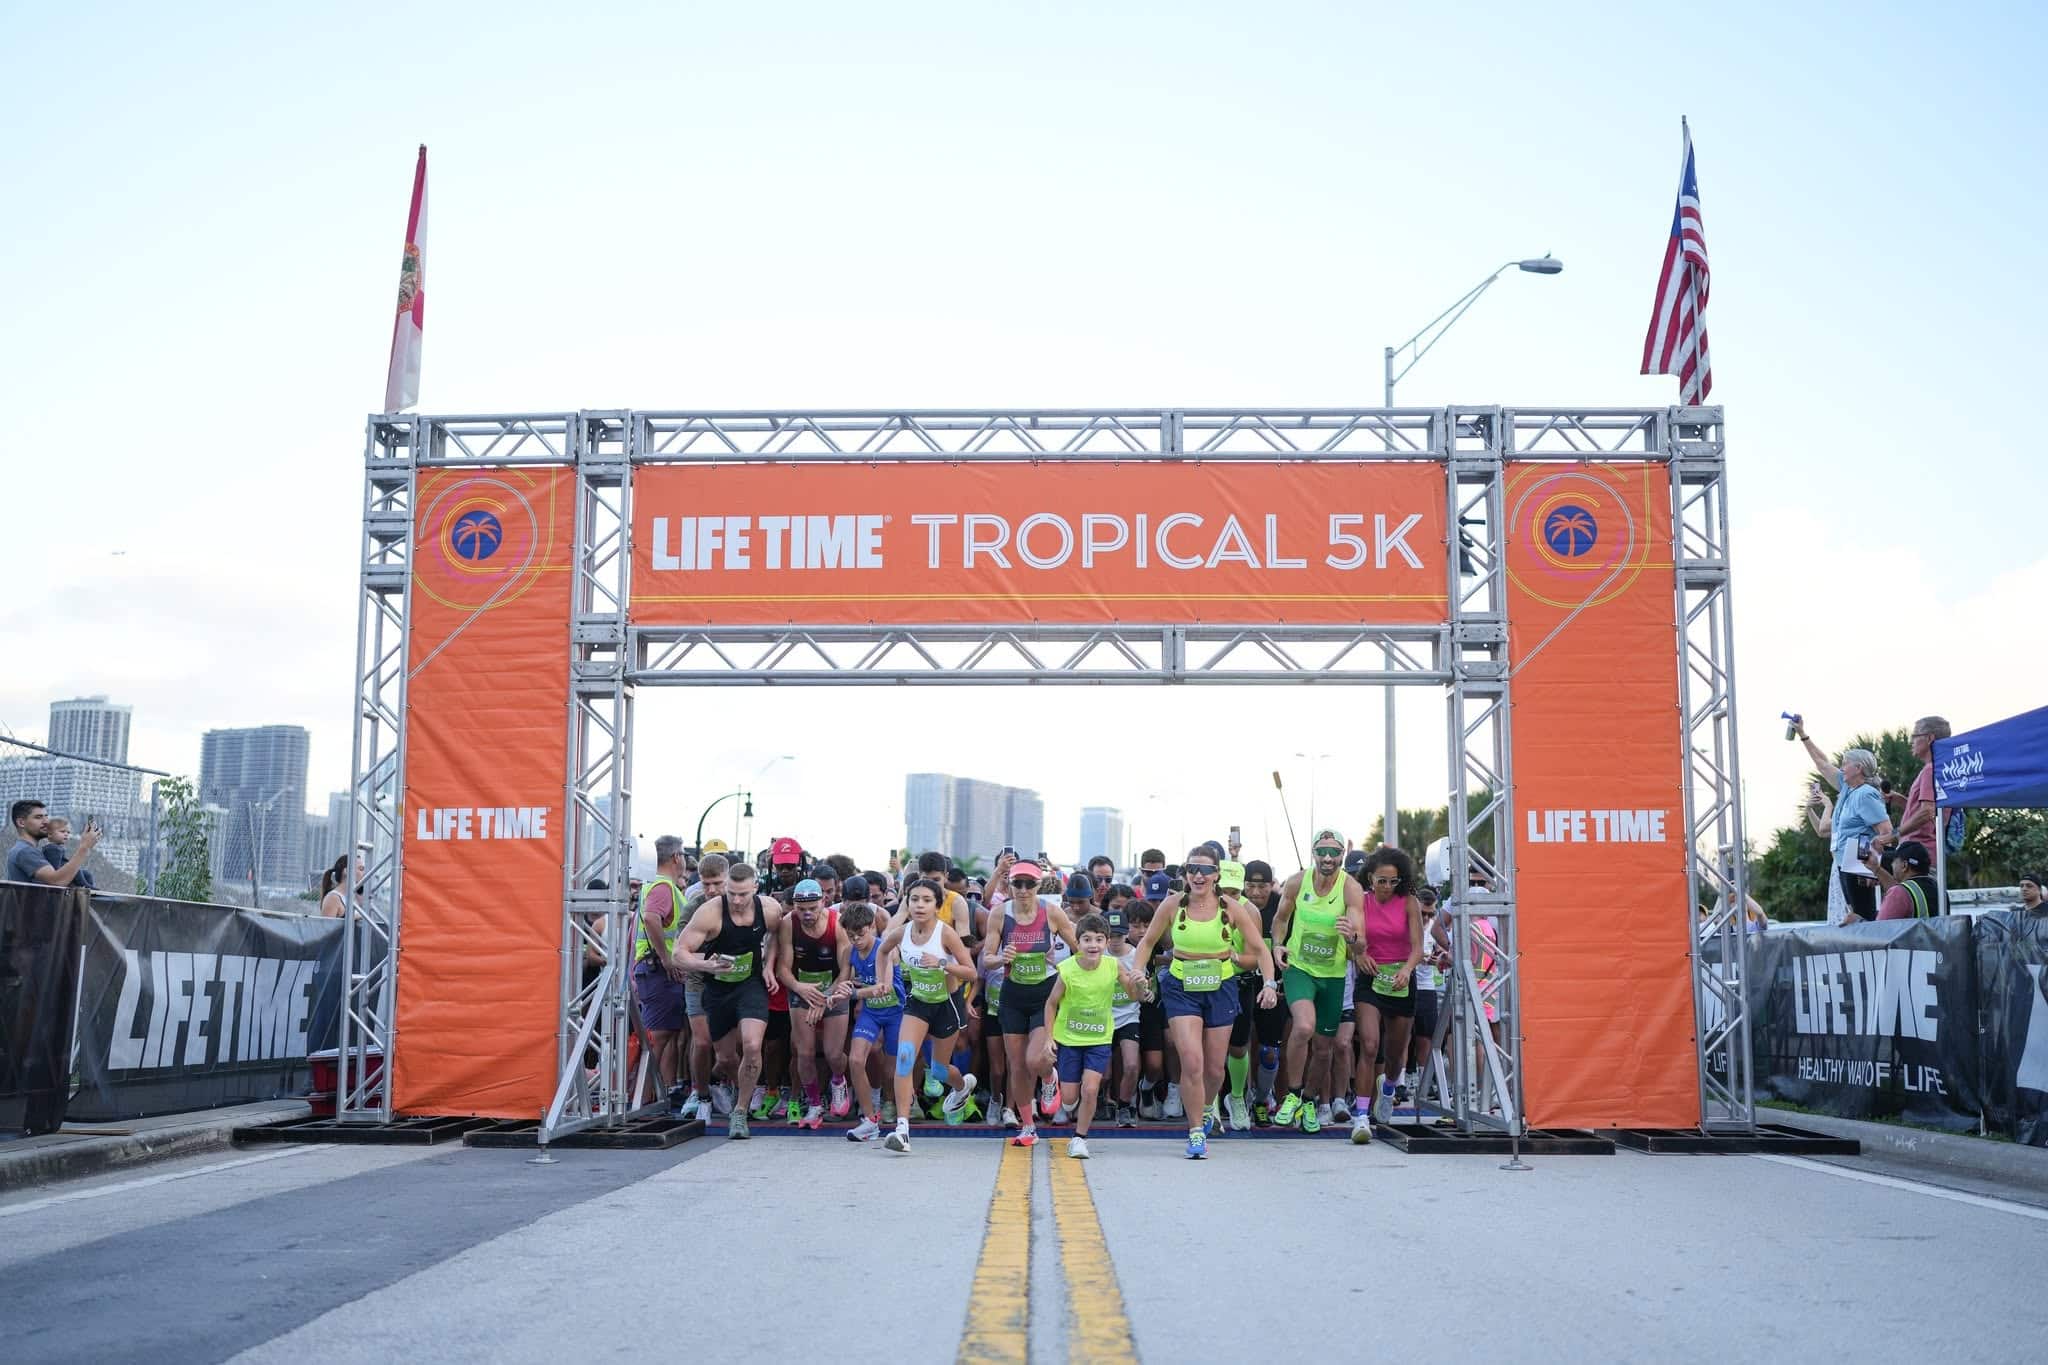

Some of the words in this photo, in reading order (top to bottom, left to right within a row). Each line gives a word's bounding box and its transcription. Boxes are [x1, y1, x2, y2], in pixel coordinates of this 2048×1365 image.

[652, 515, 751, 571] LIFE
[758, 514, 884, 570] TIME
[911, 512, 1307, 569] TROPICAL
[1325, 513, 1424, 569] 5K
[1942, 752, 1983, 781] MIAMI
[416, 808, 473, 840] LIFE
[477, 807, 547, 839] TIME
[1527, 810, 1587, 842] LIFE
[1590, 809, 1666, 842] TIME
[912, 982, 943, 992] 50527
[1185, 975, 1220, 985] 50782
[1069, 1020, 1105, 1033] 50769
[1798, 1056, 1845, 1085] HEALTHY
[1903, 1063, 1948, 1095] LIFE
